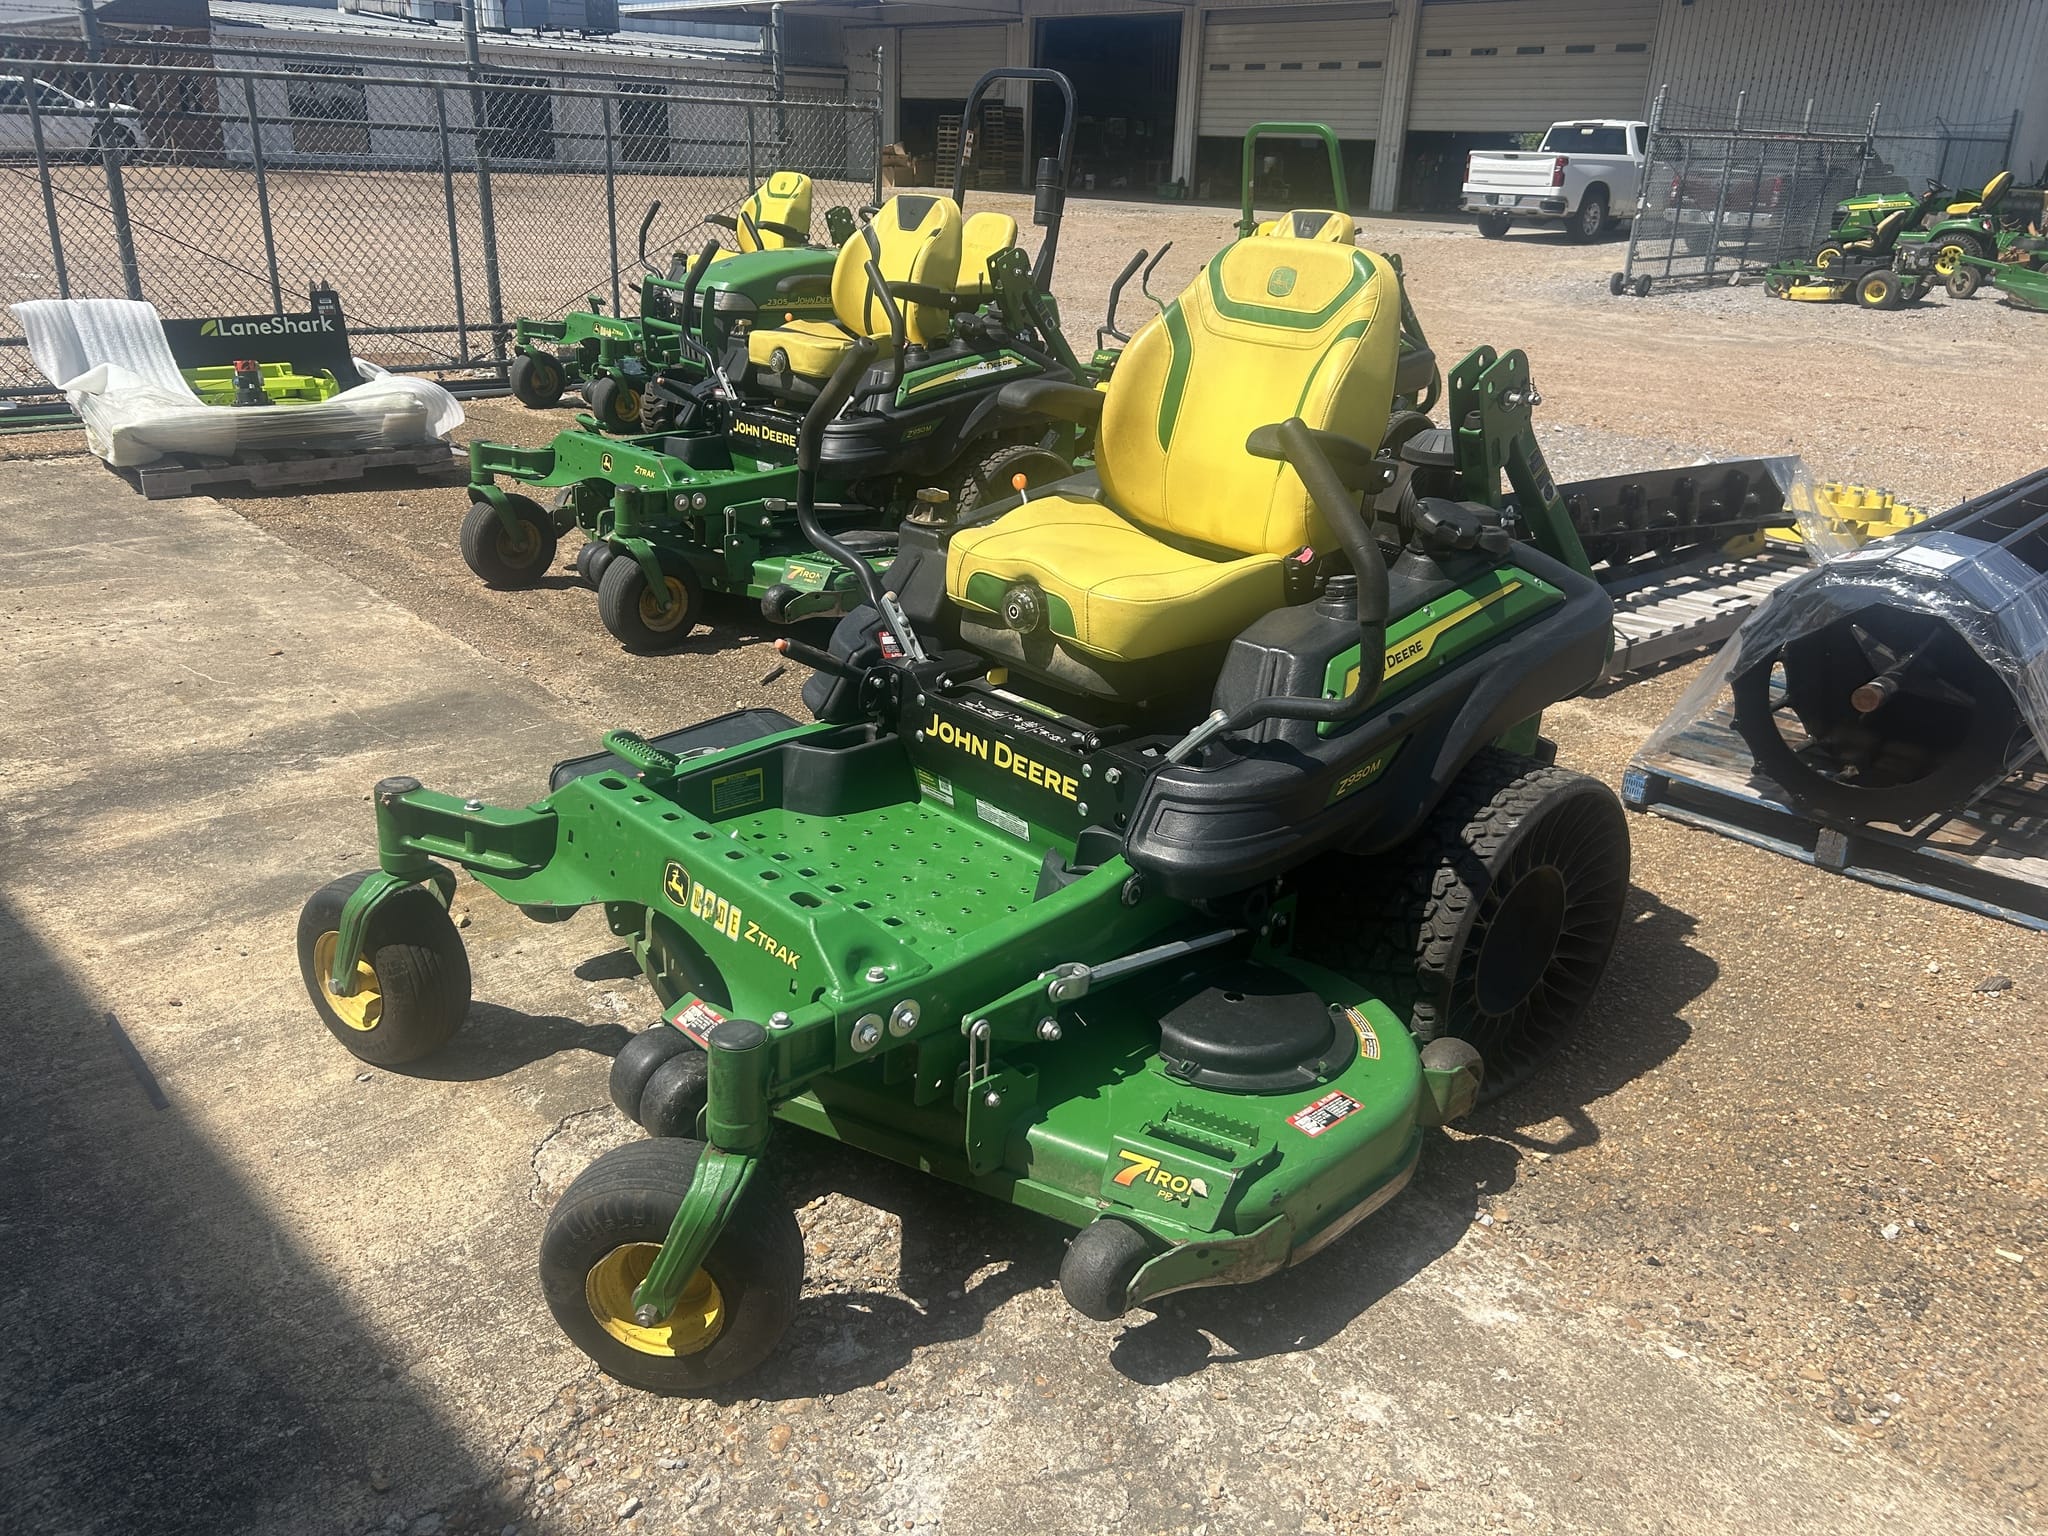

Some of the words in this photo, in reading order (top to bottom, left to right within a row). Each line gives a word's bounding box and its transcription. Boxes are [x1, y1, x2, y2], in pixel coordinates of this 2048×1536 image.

[217, 315, 335, 337] LaneShark
[732, 418, 760, 438] JOHN
[761, 425, 797, 447] DEERE
[633, 464, 655, 479] ZTRAK
[1386, 640, 1424, 669] DEERE
[925, 713, 988, 761] JOHN
[993, 739, 1079, 802] DEERE
[1335, 759, 1382, 797] Z950M
[743, 920, 801, 970] ZTRAK
